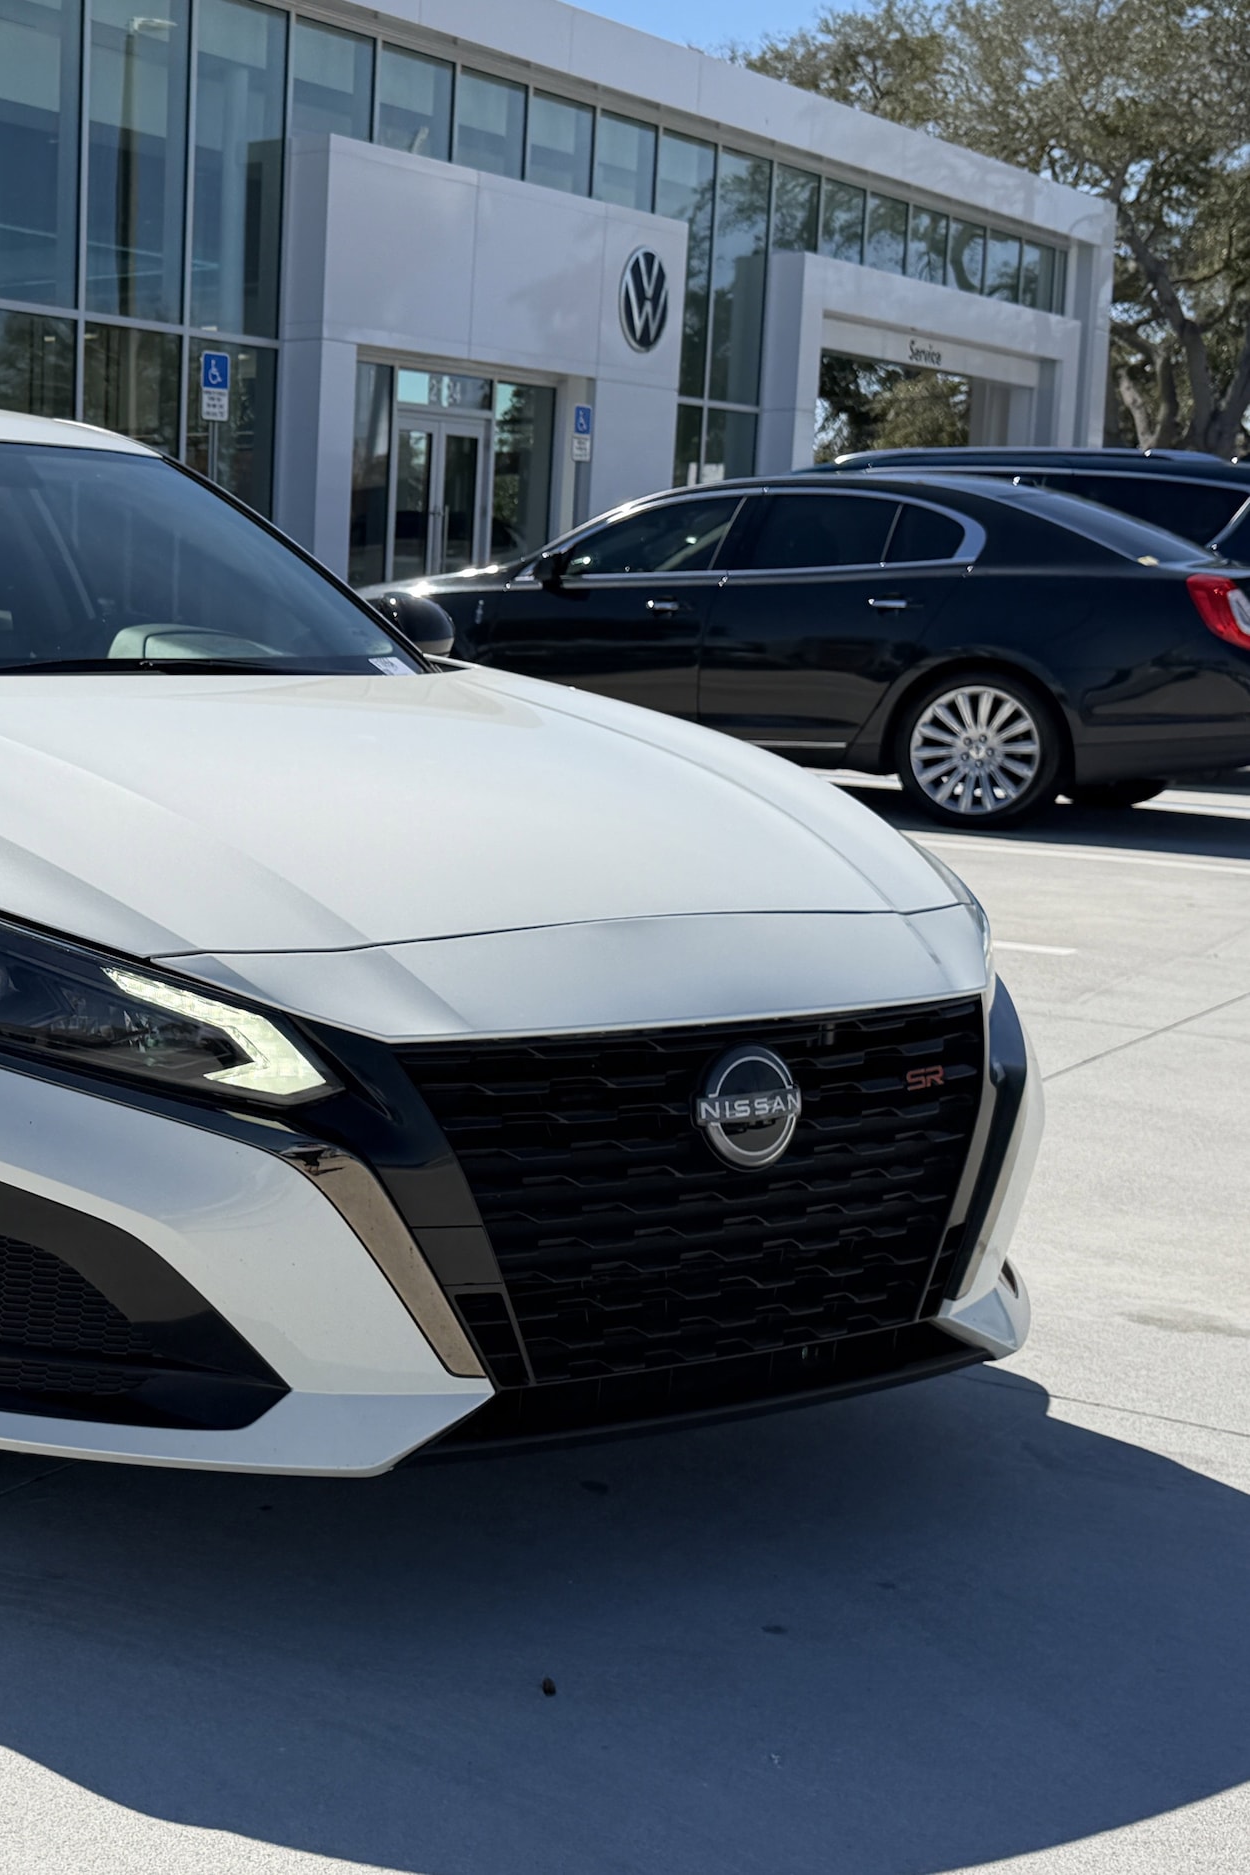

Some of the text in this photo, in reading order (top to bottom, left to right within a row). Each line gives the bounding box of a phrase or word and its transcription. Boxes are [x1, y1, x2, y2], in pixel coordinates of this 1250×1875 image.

[908, 339, 942, 366] Service
[906, 1065, 944, 1091] SR
[700, 1092, 800, 1119] NISSAN
